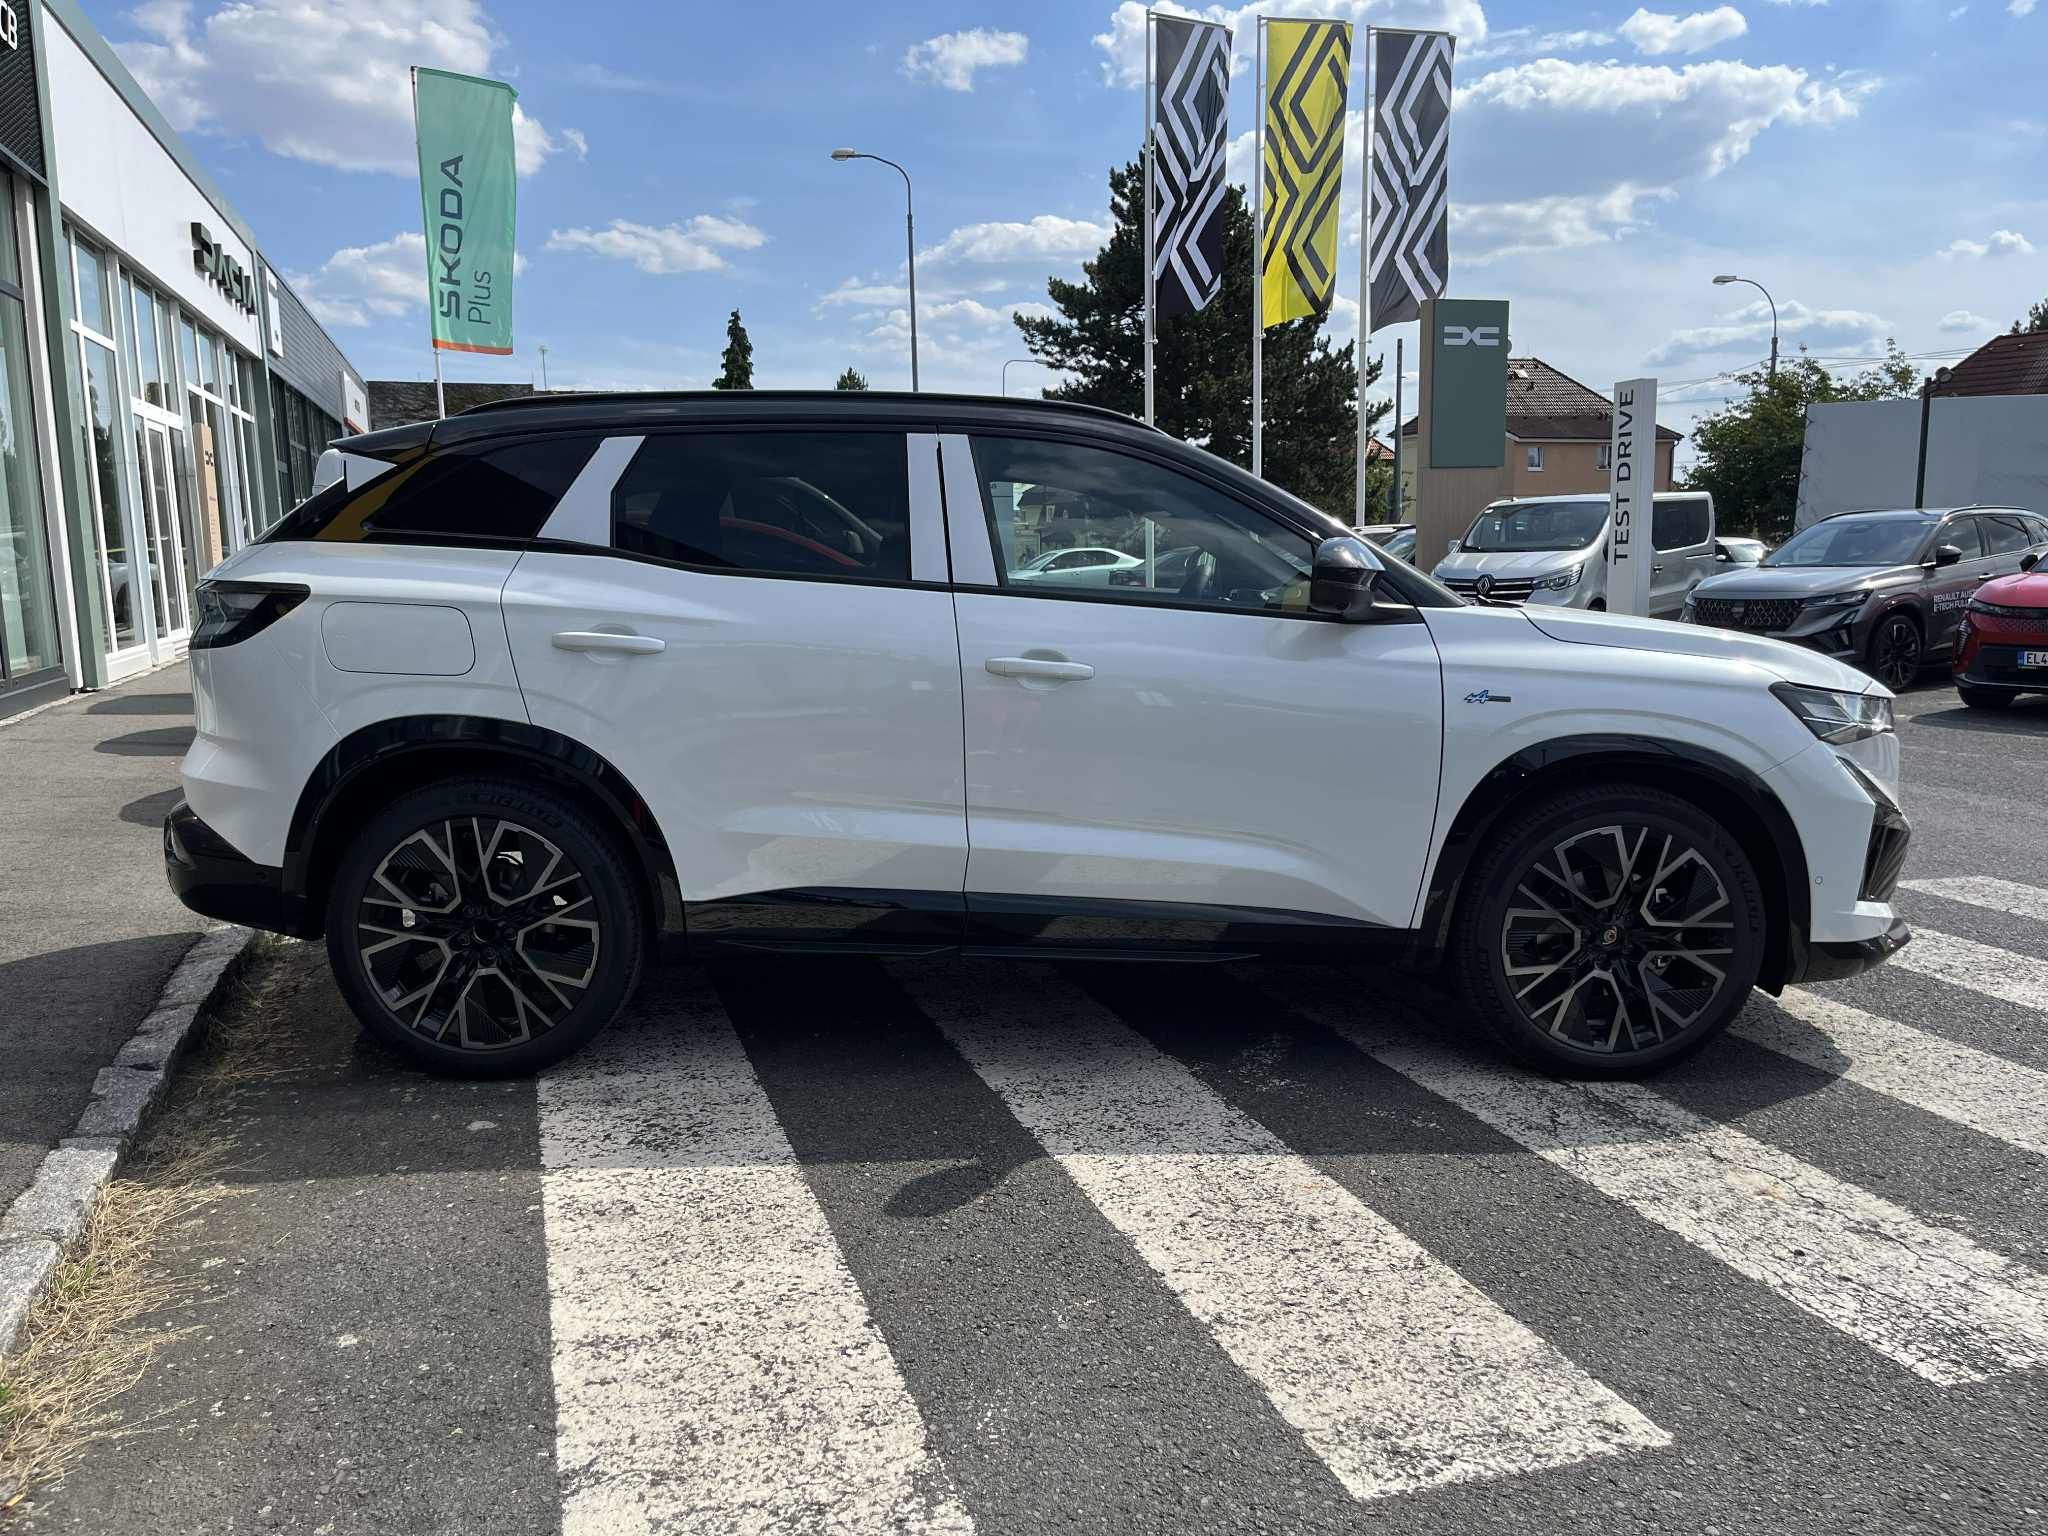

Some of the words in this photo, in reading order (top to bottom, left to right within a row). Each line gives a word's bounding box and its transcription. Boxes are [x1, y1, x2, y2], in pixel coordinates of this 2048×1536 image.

[467, 270, 492, 325] Plus
[1616, 389, 1634, 483] DRIVE
[1614, 493, 1631, 565] TEST
[1933, 591, 1960, 603] RENAULT
